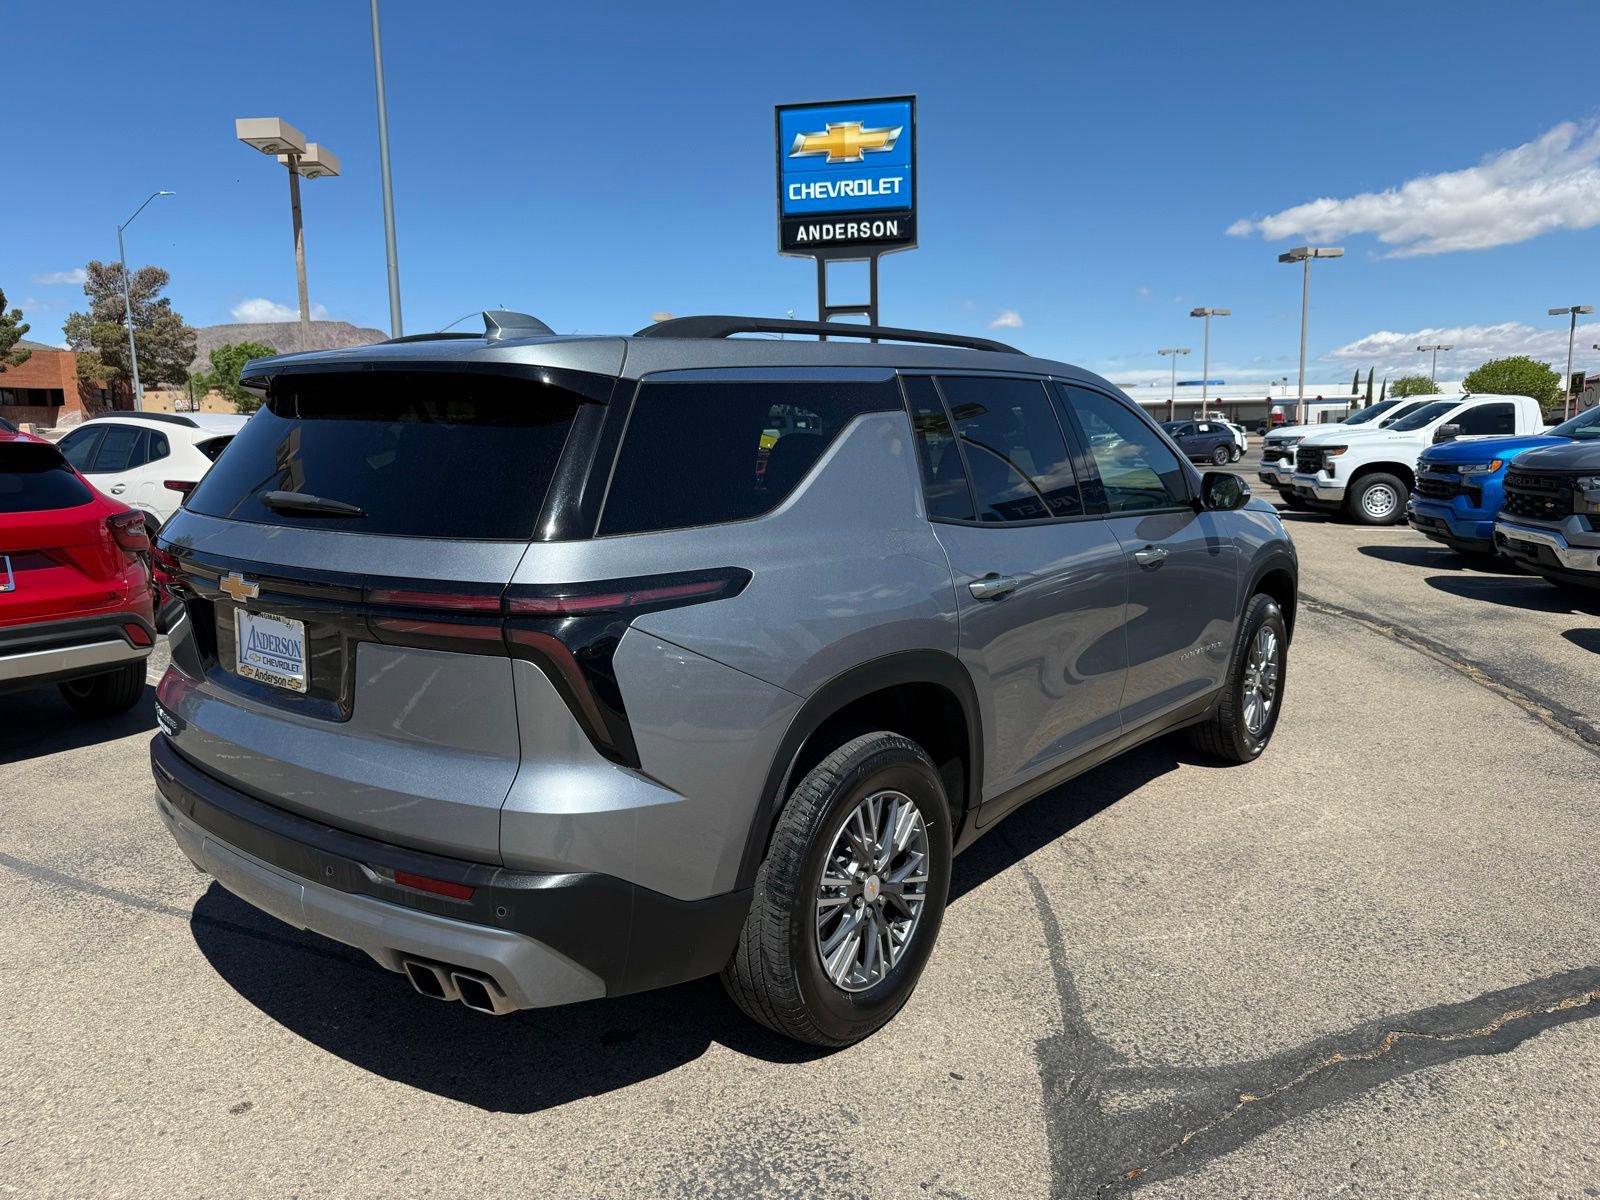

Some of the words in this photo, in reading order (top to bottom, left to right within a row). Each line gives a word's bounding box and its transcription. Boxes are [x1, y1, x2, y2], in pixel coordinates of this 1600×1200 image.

[789, 177, 903, 200] CHEVROLET
[797, 220, 898, 242] ANDERSON
[243, 625, 301, 660] ANDERSON
[262, 656, 299, 673] CHEVROLET
[254, 668, 286, 686] Anderson
